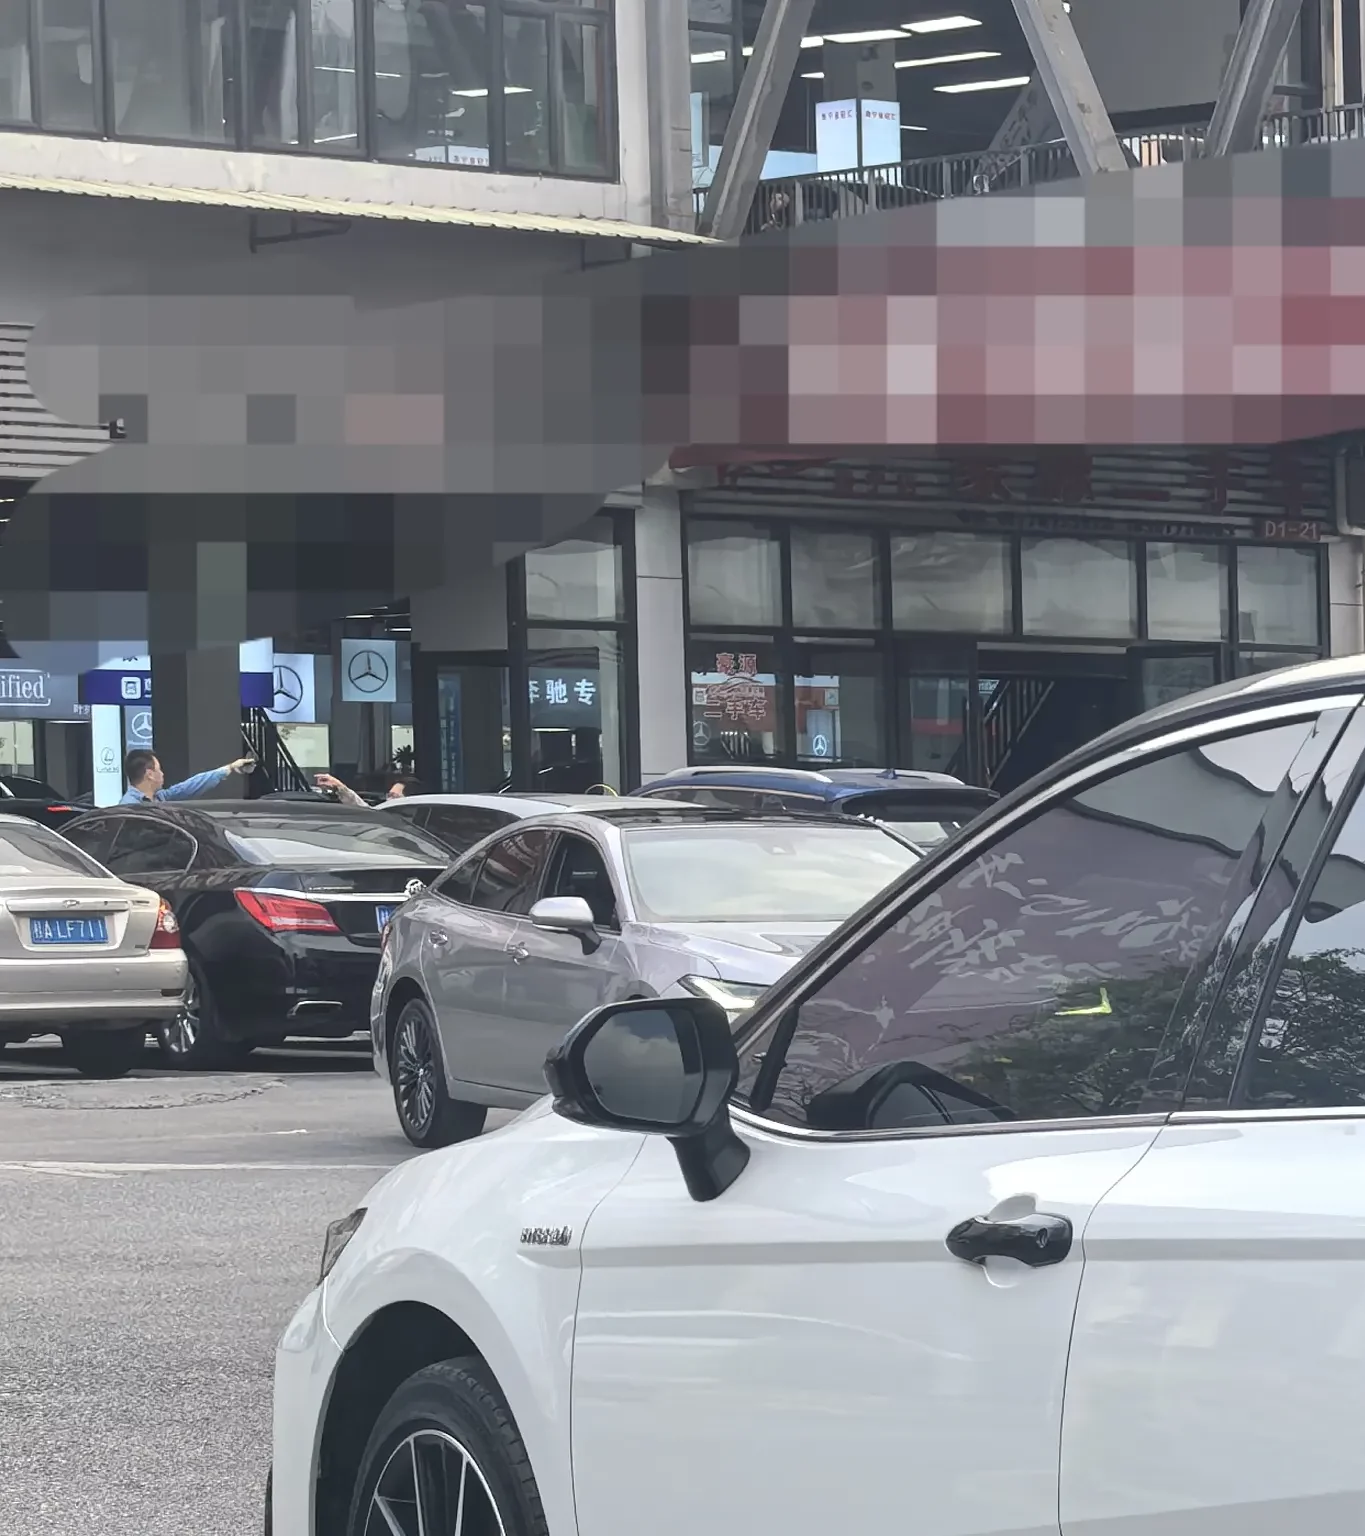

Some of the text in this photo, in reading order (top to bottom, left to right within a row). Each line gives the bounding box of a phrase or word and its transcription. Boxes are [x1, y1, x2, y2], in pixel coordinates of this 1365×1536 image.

[1265, 520, 1318, 540] D1-21
[703, 698, 768, 720] 二手车
